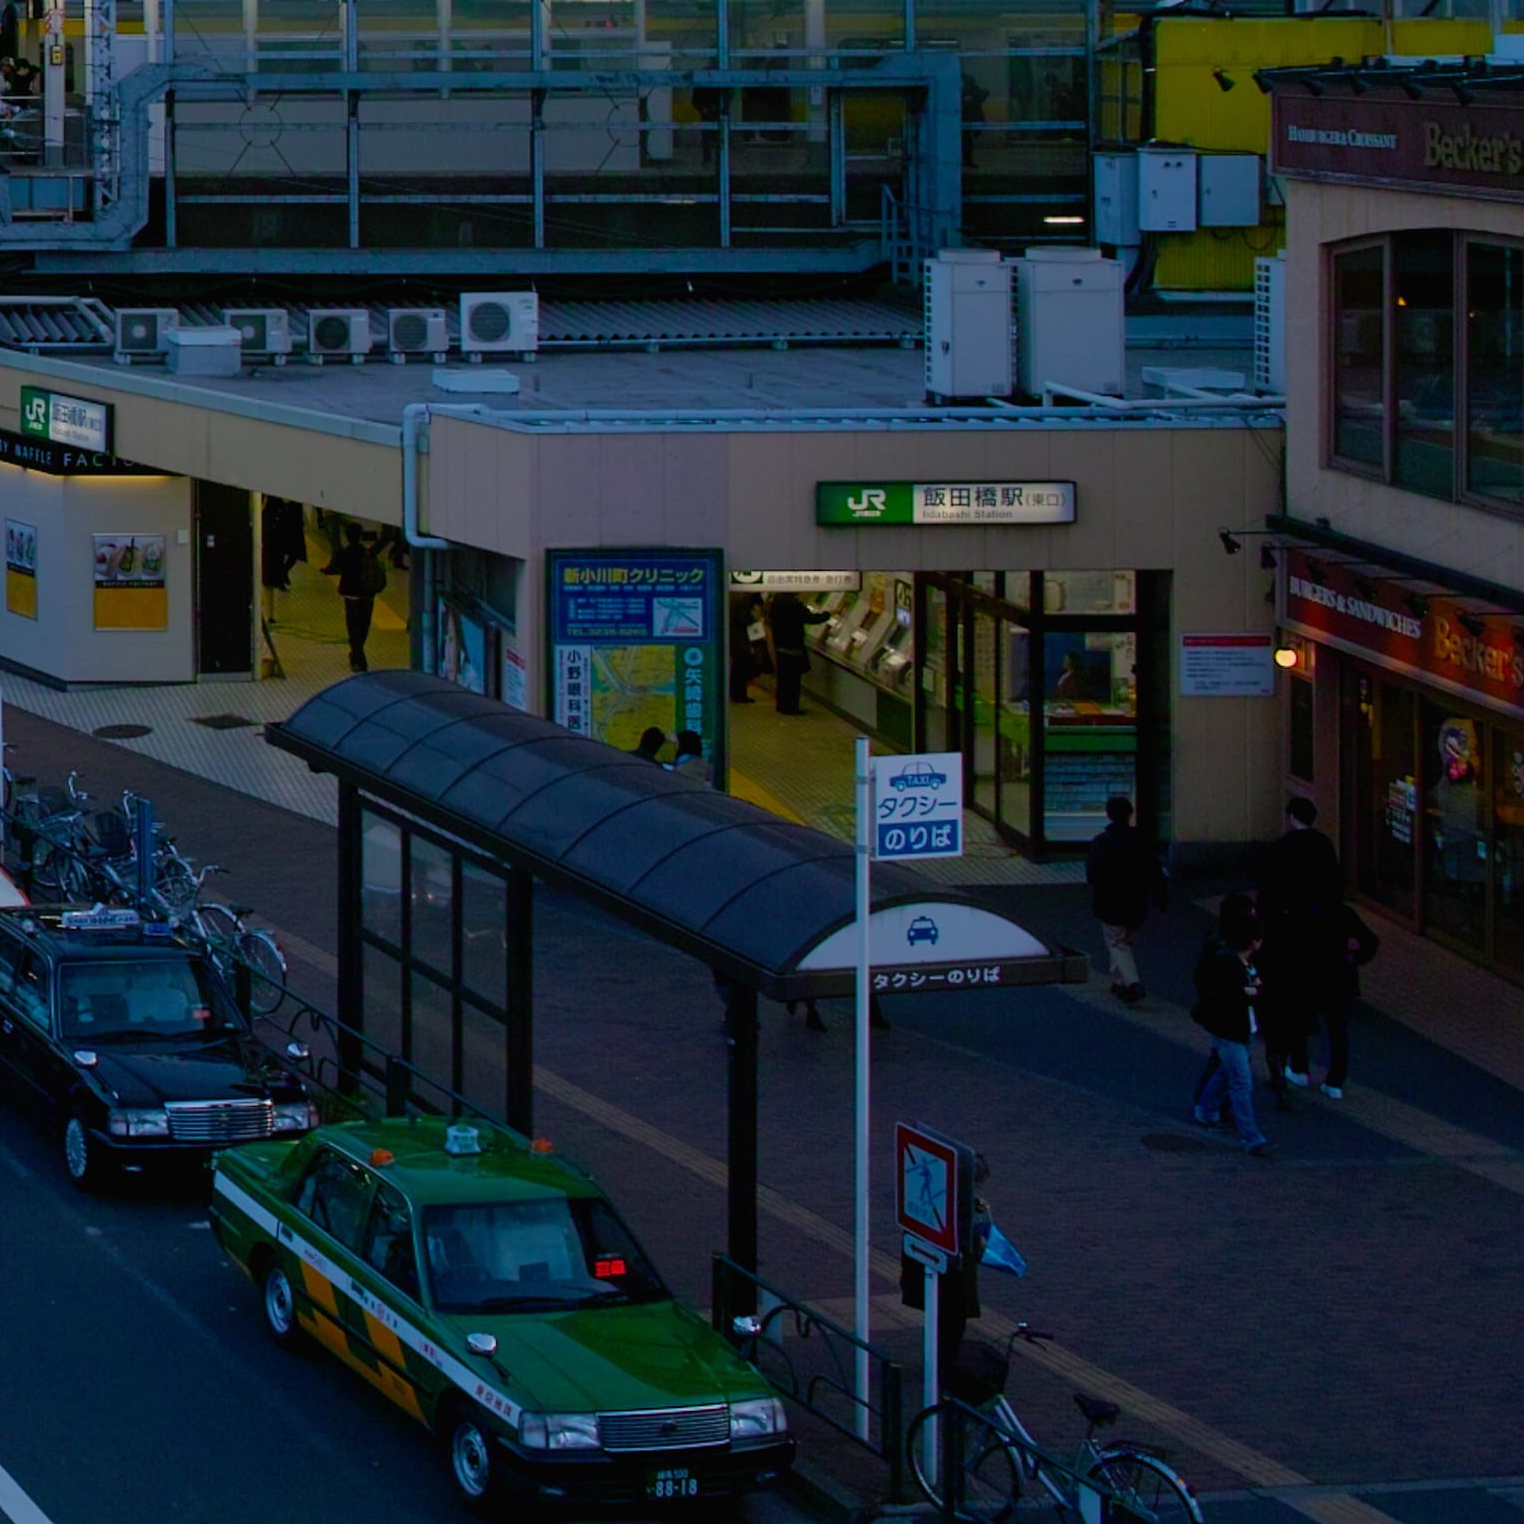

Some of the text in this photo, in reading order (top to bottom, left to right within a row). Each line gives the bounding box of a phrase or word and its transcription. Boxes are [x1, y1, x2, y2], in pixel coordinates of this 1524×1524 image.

[1423, 121, 1524, 174] Becker's
[25, 396, 47, 424] JR
[847, 488, 887, 512] JR
[923, 486, 1023, 508] 飯田橋駅
[974, 509, 1013, 519] Station
[1348, 596, 1422, 639] SANDWICHES
[906, 775, 930, 787] TAXI
[878, 795, 957, 819] タクシー
[884, 824, 952, 850] のりば
[873, 966, 1000, 989] タクシーのりば
[655, 1477, 698, 1498] 88-18
